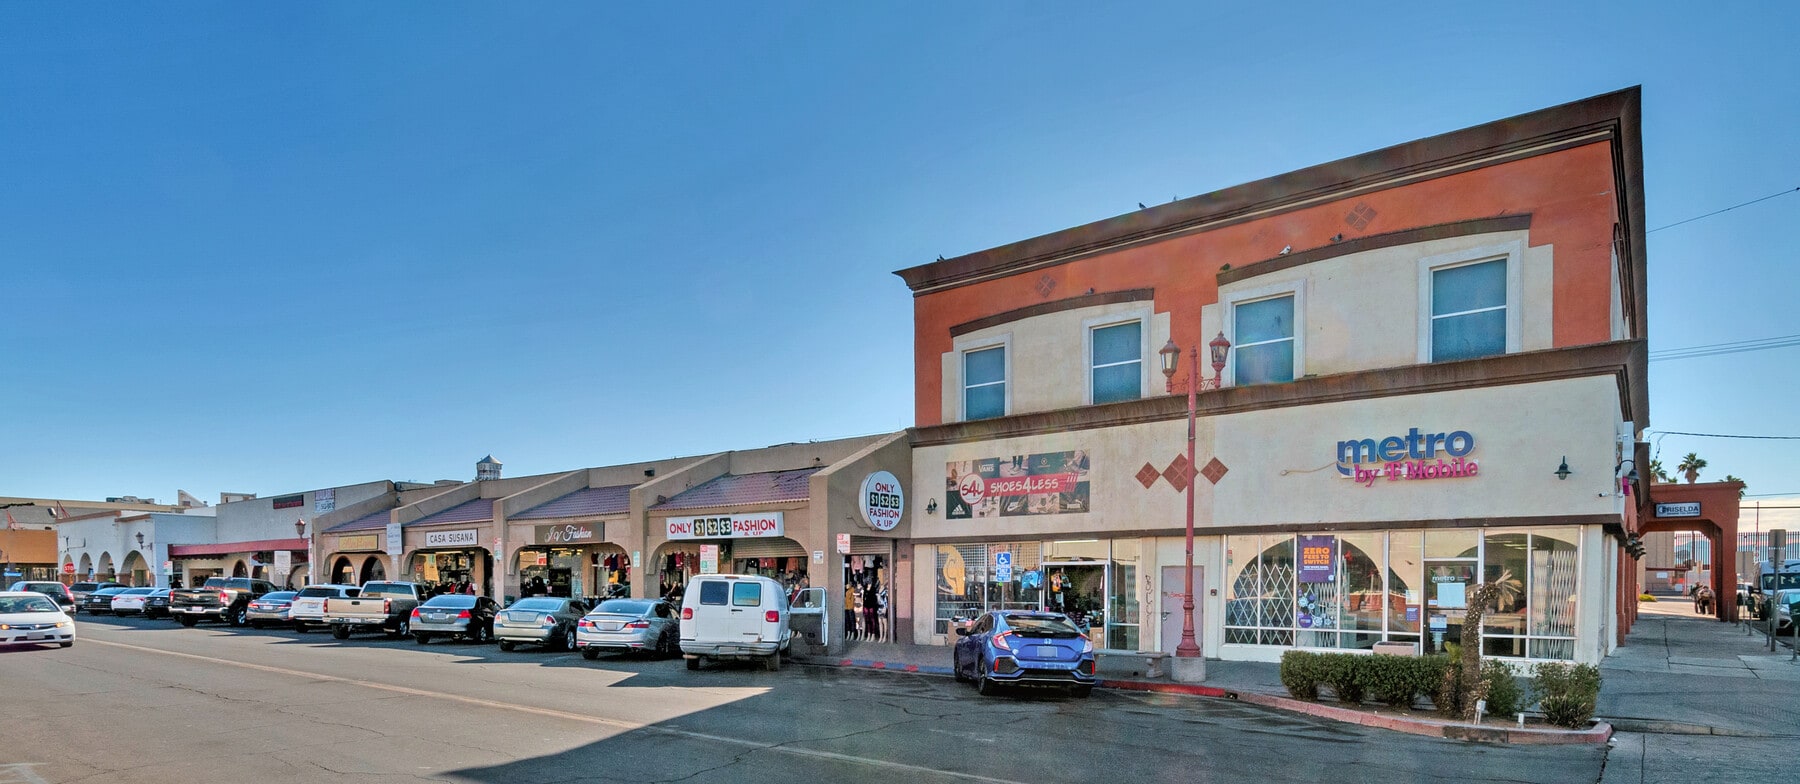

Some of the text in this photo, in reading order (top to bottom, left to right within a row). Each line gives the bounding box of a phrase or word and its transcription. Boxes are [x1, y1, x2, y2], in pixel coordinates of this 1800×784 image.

[1337, 427, 1474, 464] metro
[1354, 464, 1379, 487] by
[1405, 457, 1477, 480] Mobile
[875, 482, 895, 493] ONLY
[961, 479, 984, 497] S4L
[990, 477, 1059, 493] SHOES4LESS
[871, 495, 899, 507] $1 $2 $3
[869, 508, 900, 518] FASHION
[669, 519, 776, 535] ONLY $1 $2 $3 FASHION
[876, 519, 881, 527] &
[429, 532, 473, 543] CASA SUSANA
[563, 525, 592, 542] Fashion
[1303, 547, 1330, 555] ZERO
[1432, 575, 1455, 583] metro
